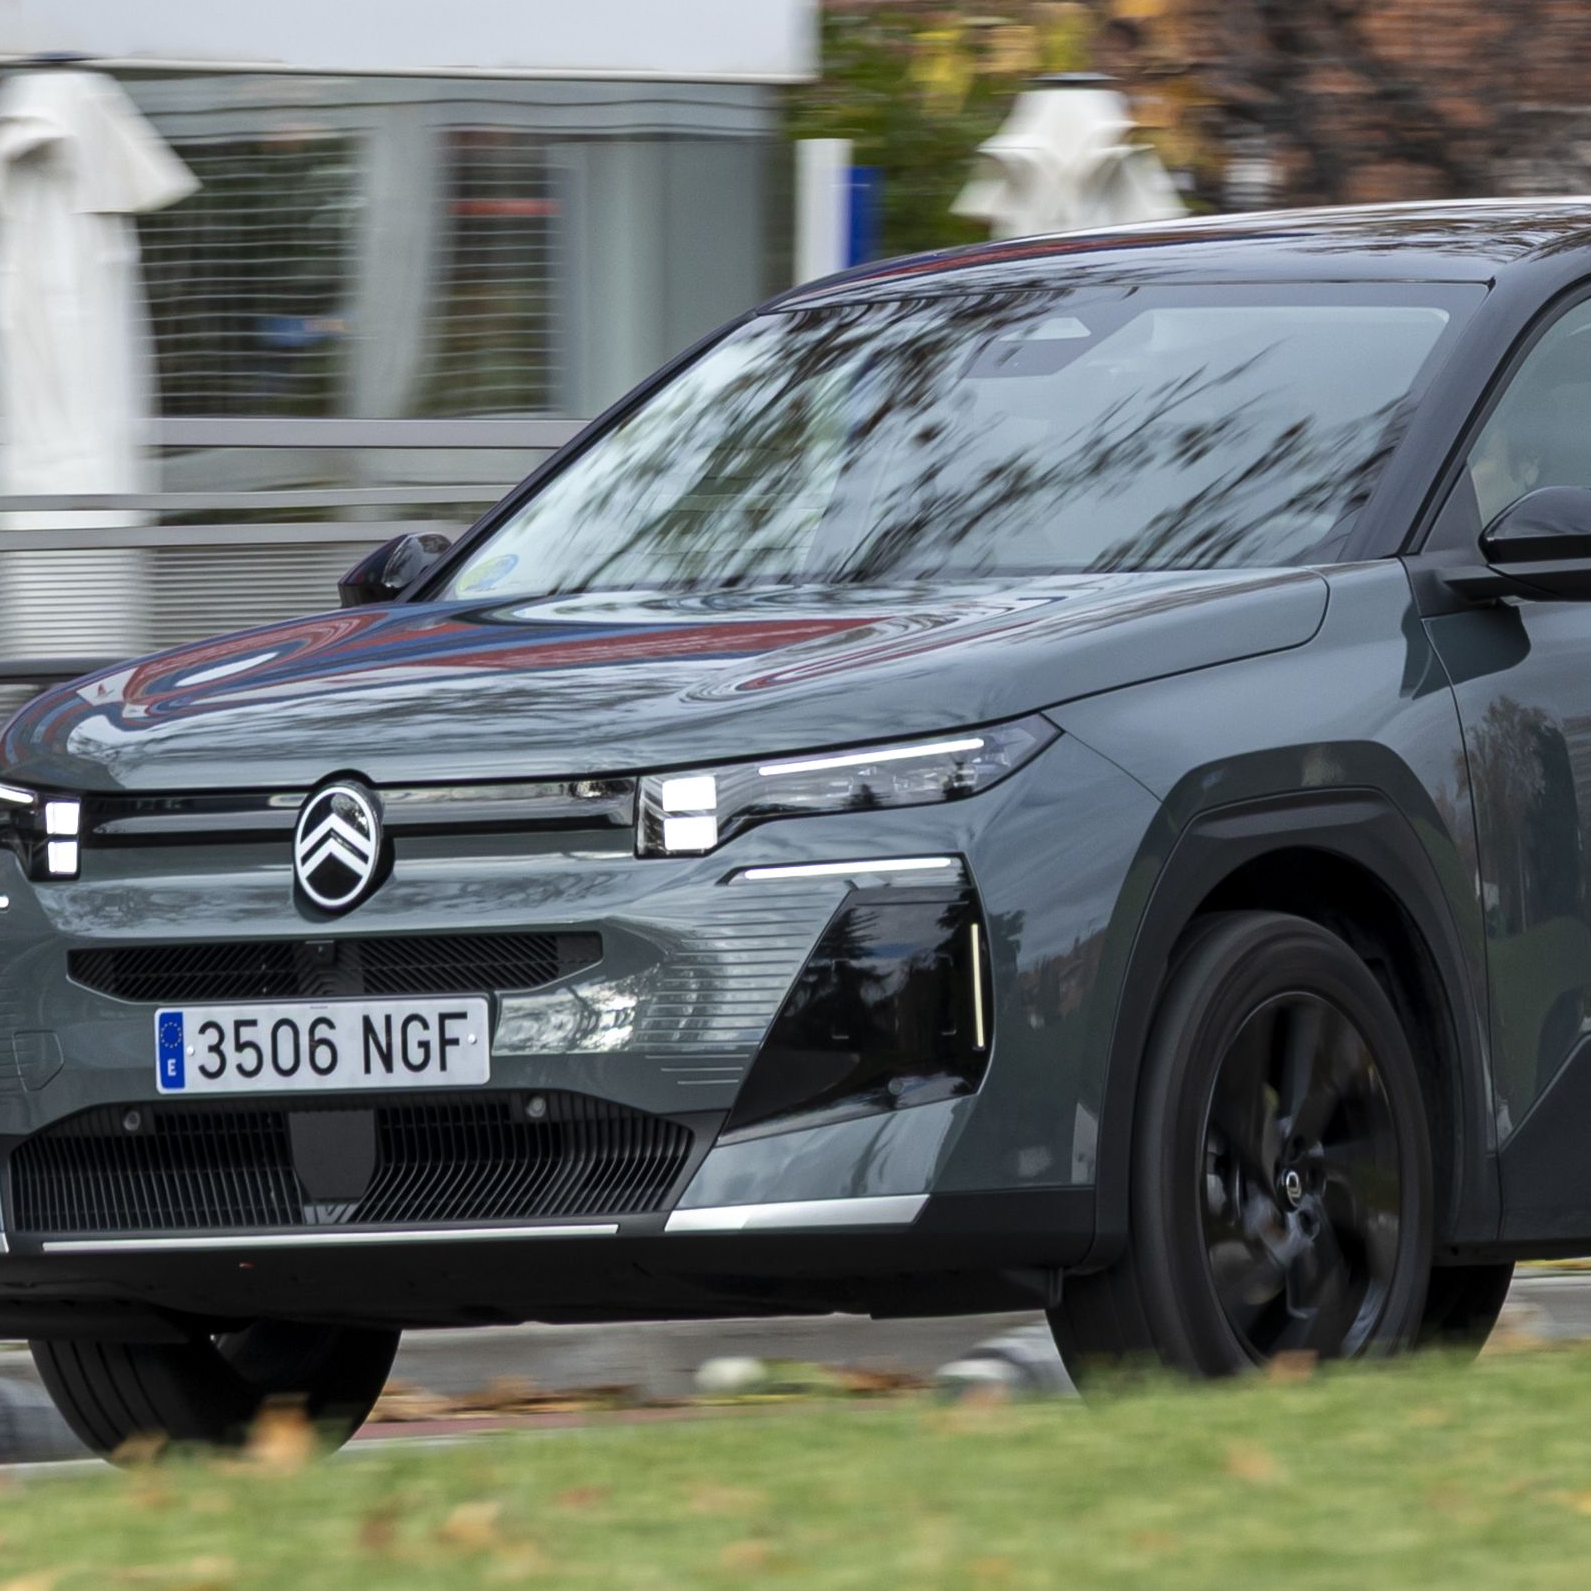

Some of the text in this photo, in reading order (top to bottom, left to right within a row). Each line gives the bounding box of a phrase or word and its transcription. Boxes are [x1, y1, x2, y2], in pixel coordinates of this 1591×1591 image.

[198, 1011, 468, 1080] 3506 NGF
[167, 1059, 176, 1076] E
